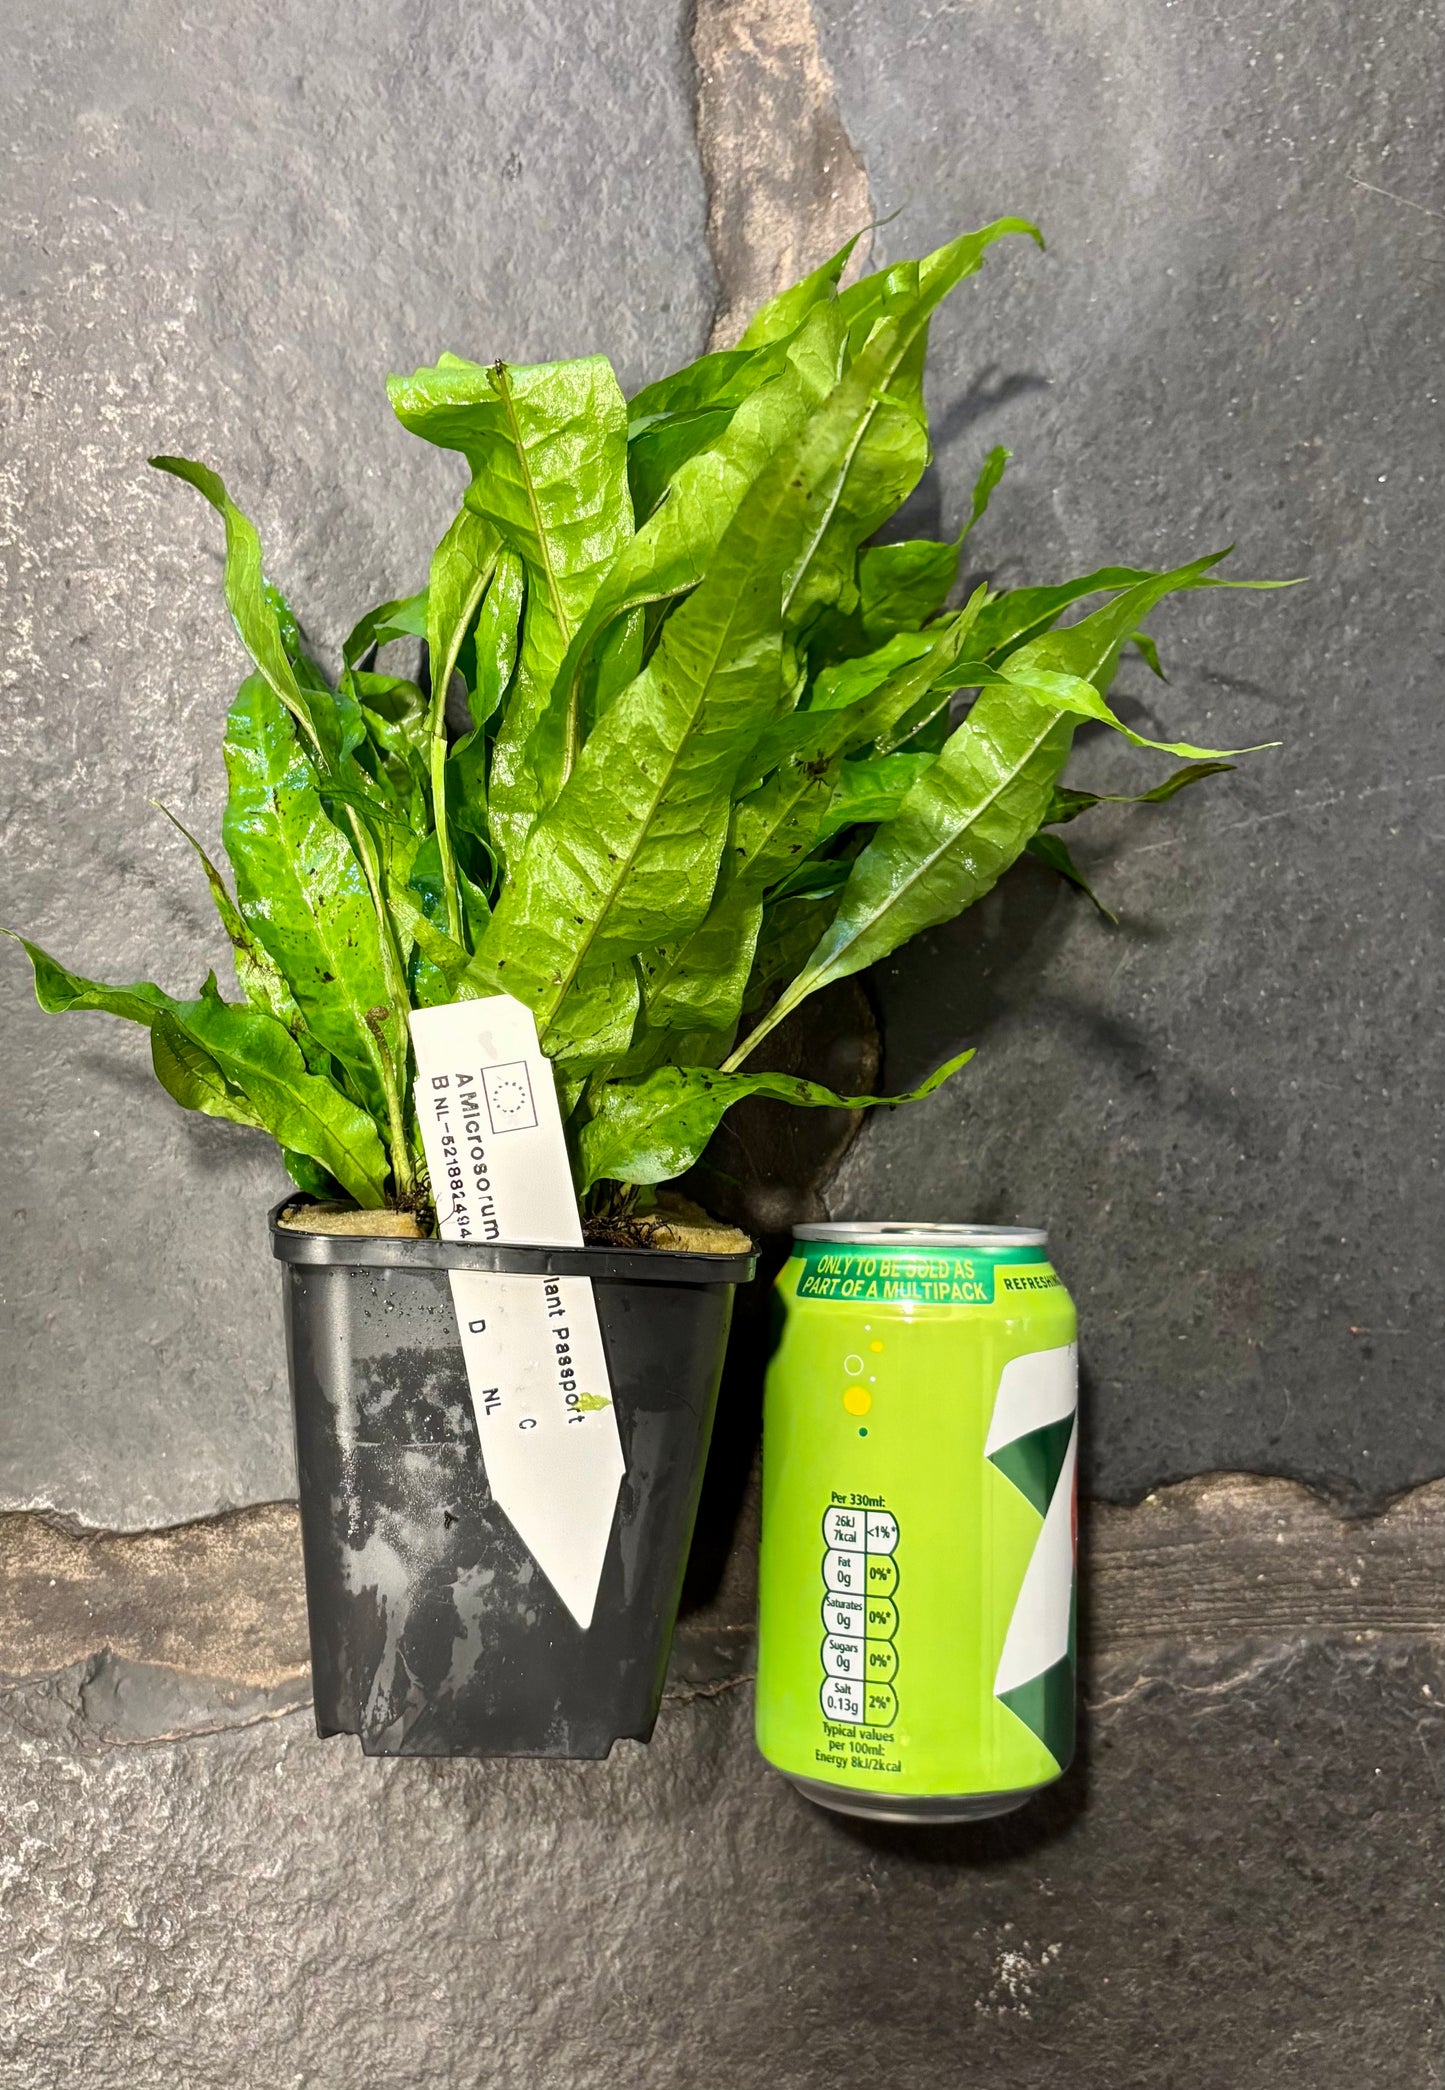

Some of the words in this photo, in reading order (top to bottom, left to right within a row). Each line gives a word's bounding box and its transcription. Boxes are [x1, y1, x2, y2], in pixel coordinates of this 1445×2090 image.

[431, 1075, 450, 1089] B
[455, 1073, 473, 1087] A
[817, 1255, 850, 1275] ONLY
[856, 1257, 877, 1276] TO
[880, 1259, 900, 1277] BE
[905, 1260, 949, 1279] SOLD
[954, 1260, 975, 1279] AS
[543, 1277, 566, 1317] lant
[802, 1277, 840, 1295] PART
[841, 1279, 863, 1297] OF
[863, 1280, 878, 1297] A
[883, 1282, 988, 1300] MULTIPACK
[469, 1319, 486, 1334] D
[482, 1388, 501, 1416] NL
[552, 1327, 585, 1424] Passport
[518, 1418, 537, 1430] C
[831, 1491, 847, 1503] Per
[834, 1529, 856, 1542] 7kcal
[838, 1556, 851, 1567] Fat
[837, 1570, 851, 1587] 0g
[826, 1597, 862, 1611] Saturates
[837, 1612, 851, 1629] 0g
[829, 1639, 858, 1653] Sugars
[836, 1654, 850, 1672] 0g
[834, 1682, 851, 1695] Salt
[827, 1696, 858, 1715] 0.13g
[823, 1721, 856, 1737] Typical
[860, 1728, 894, 1742] values
[829, 1740, 845, 1751] per
[815, 1749, 848, 1768] Energy
